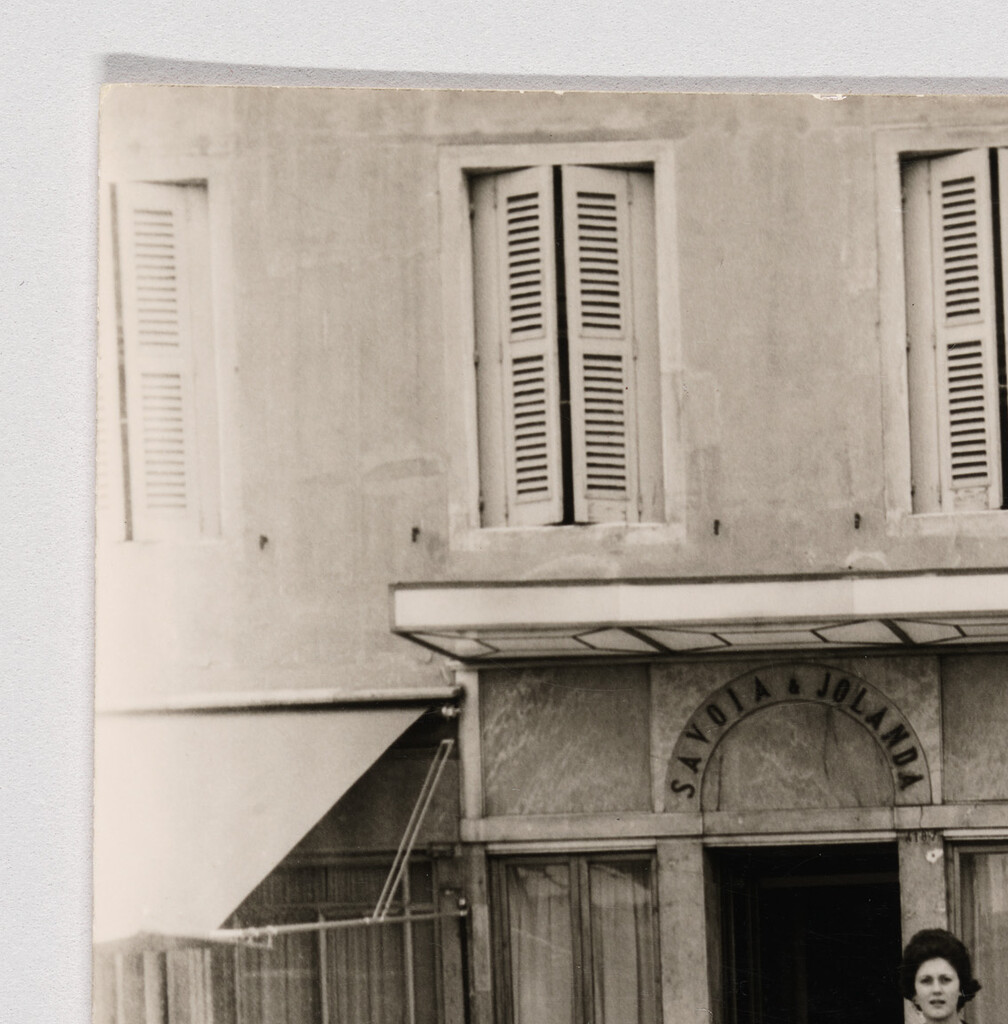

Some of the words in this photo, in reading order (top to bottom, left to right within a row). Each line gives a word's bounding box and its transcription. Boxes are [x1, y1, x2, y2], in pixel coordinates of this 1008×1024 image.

[670, 675, 772, 799] SAVOIA
[787, 675, 801, 695] &
[816, 672, 925, 792] JOLANDA
